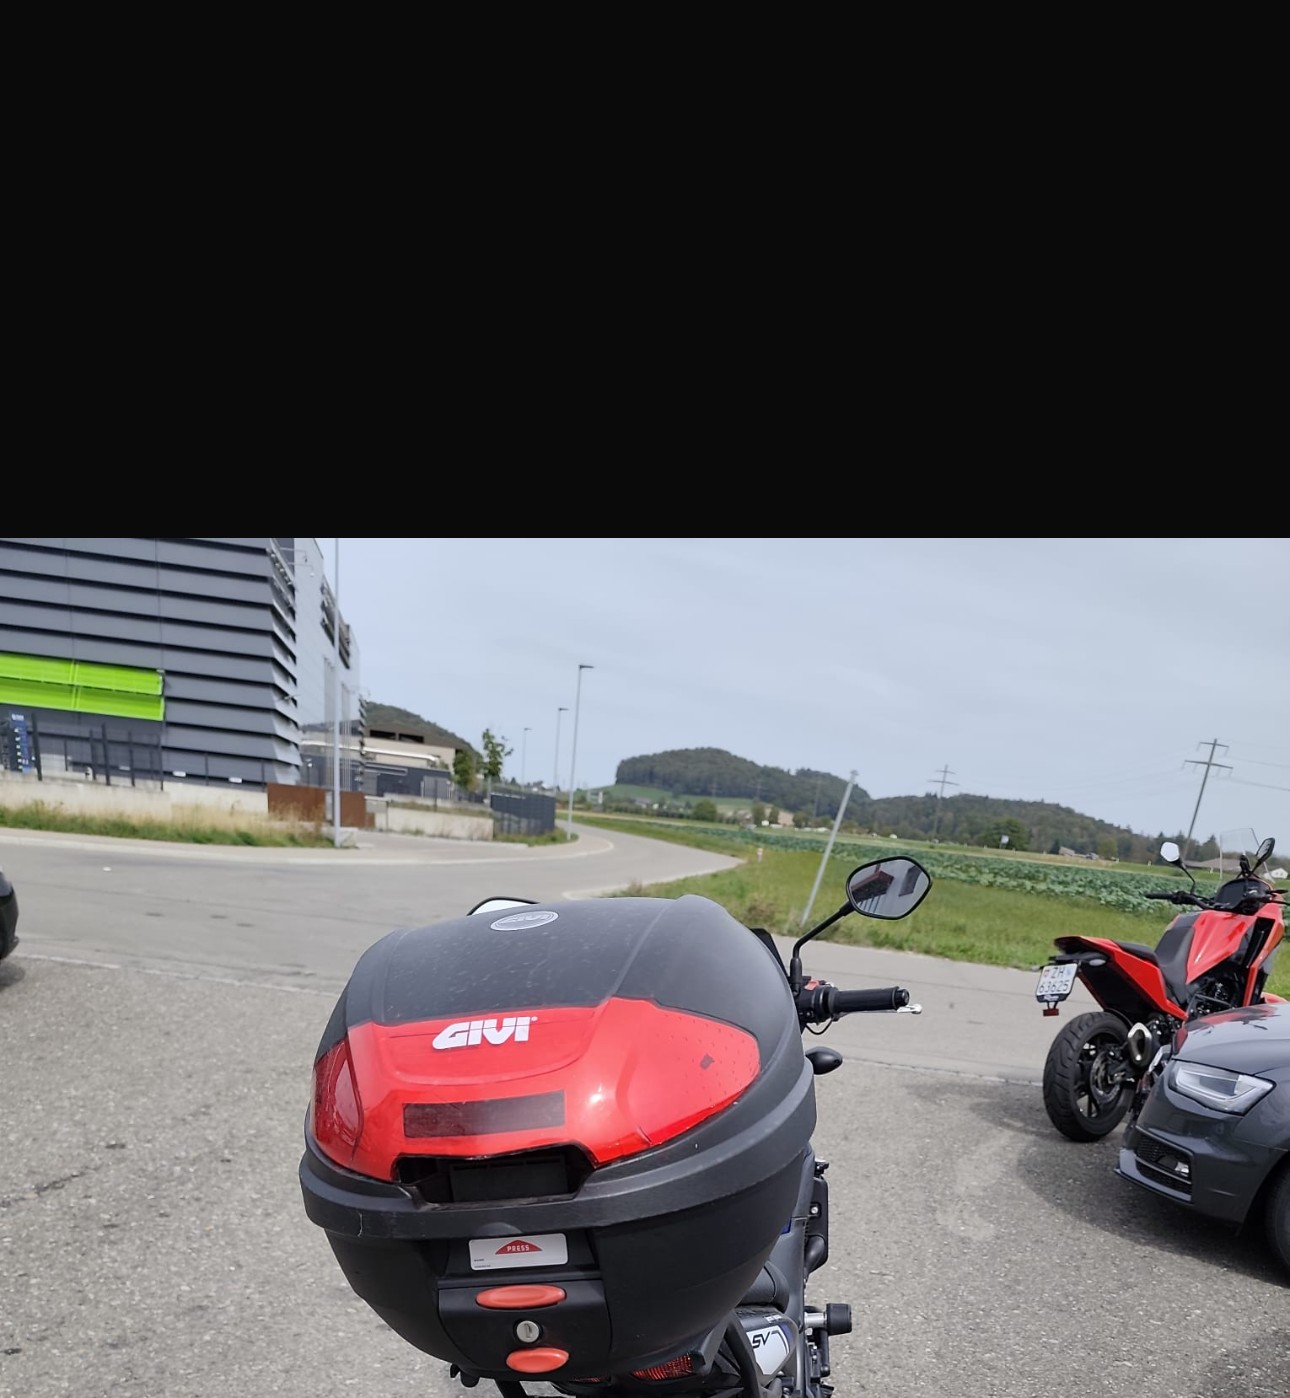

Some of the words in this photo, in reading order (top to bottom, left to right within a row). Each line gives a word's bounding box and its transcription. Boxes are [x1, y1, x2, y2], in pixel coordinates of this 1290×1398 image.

[1051, 966, 1066, 979] ZH
[1039, 979, 1070, 993] 63625
[432, 1016, 531, 1050] GIVI
[506, 1244, 530, 1252] PRESS
[752, 1331, 771, 1349] SV
